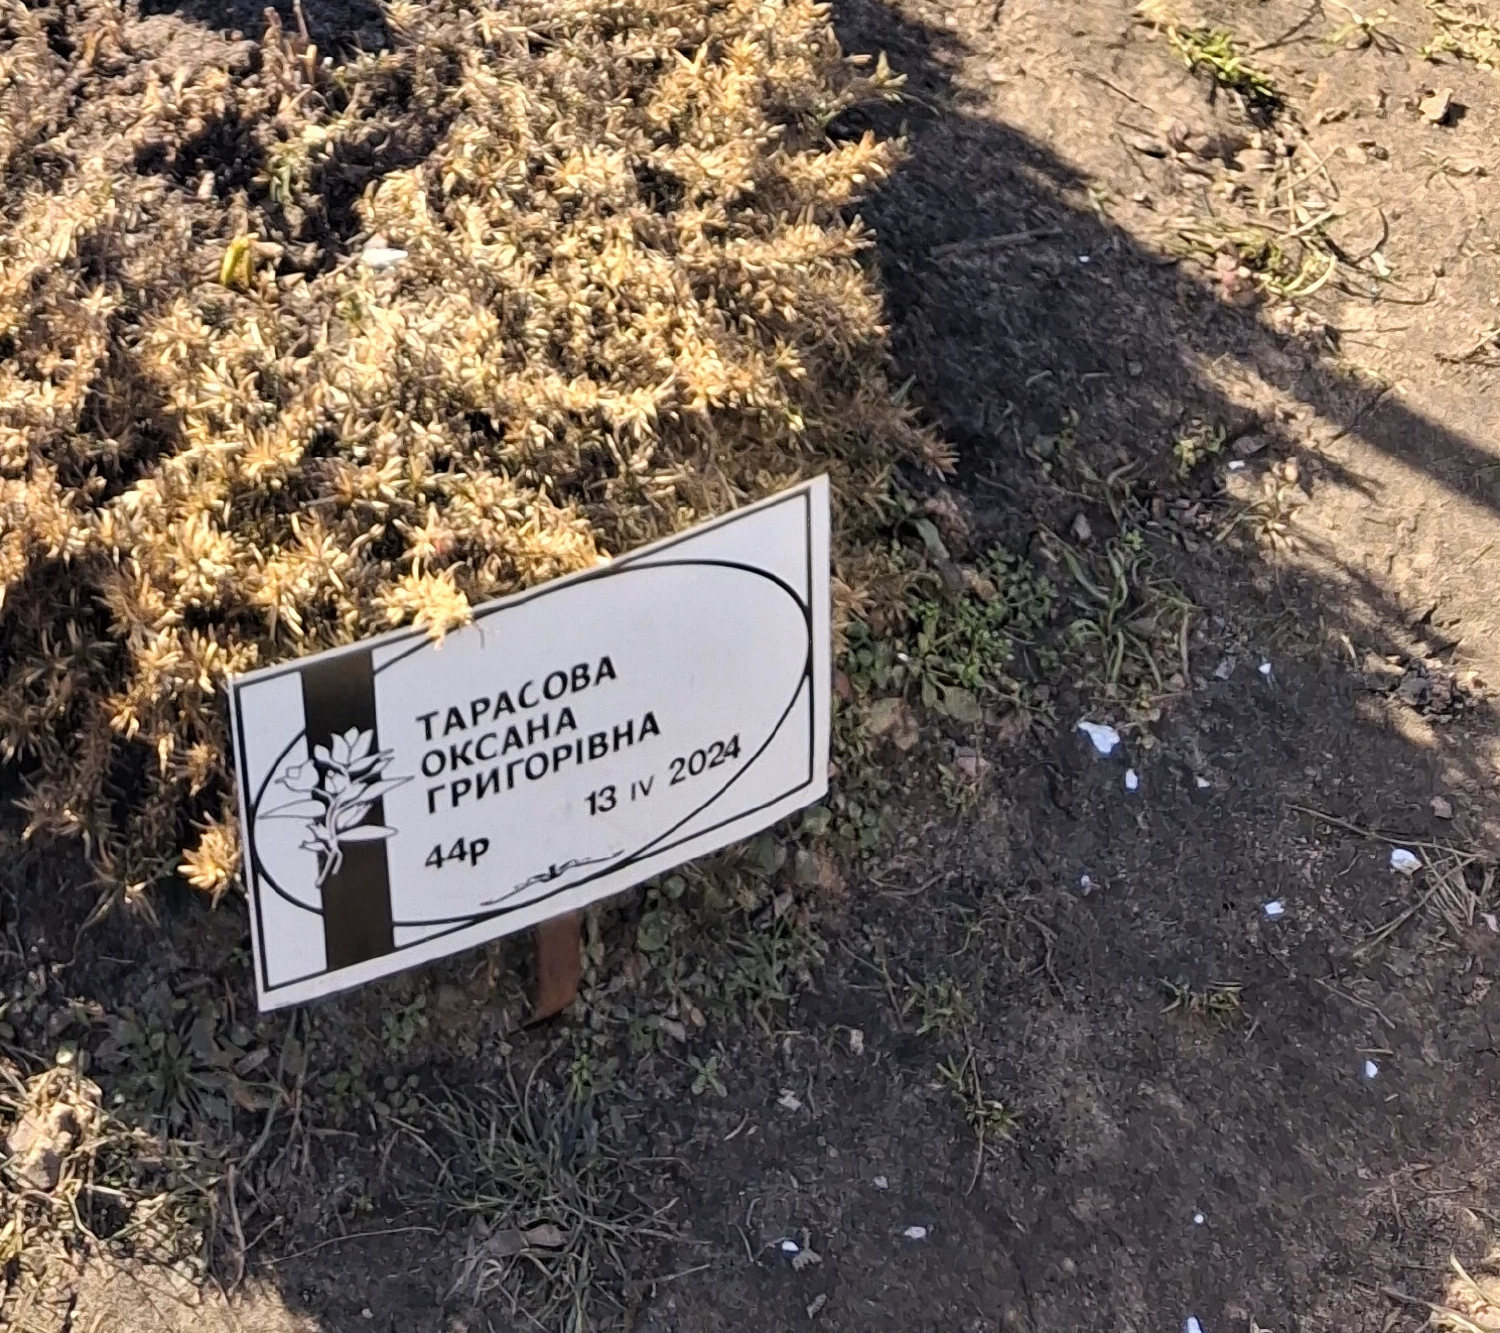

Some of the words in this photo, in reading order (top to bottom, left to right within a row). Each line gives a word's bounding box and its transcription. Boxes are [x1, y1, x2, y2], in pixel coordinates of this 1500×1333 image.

[415, 655, 617, 742] ТАРАСОВА
[420, 707, 578, 779] ОКСАНА
[427, 712, 661, 814] ГРИГОРІВНА
[585, 788, 617, 816] 13
[669, 734, 742, 787] 2024
